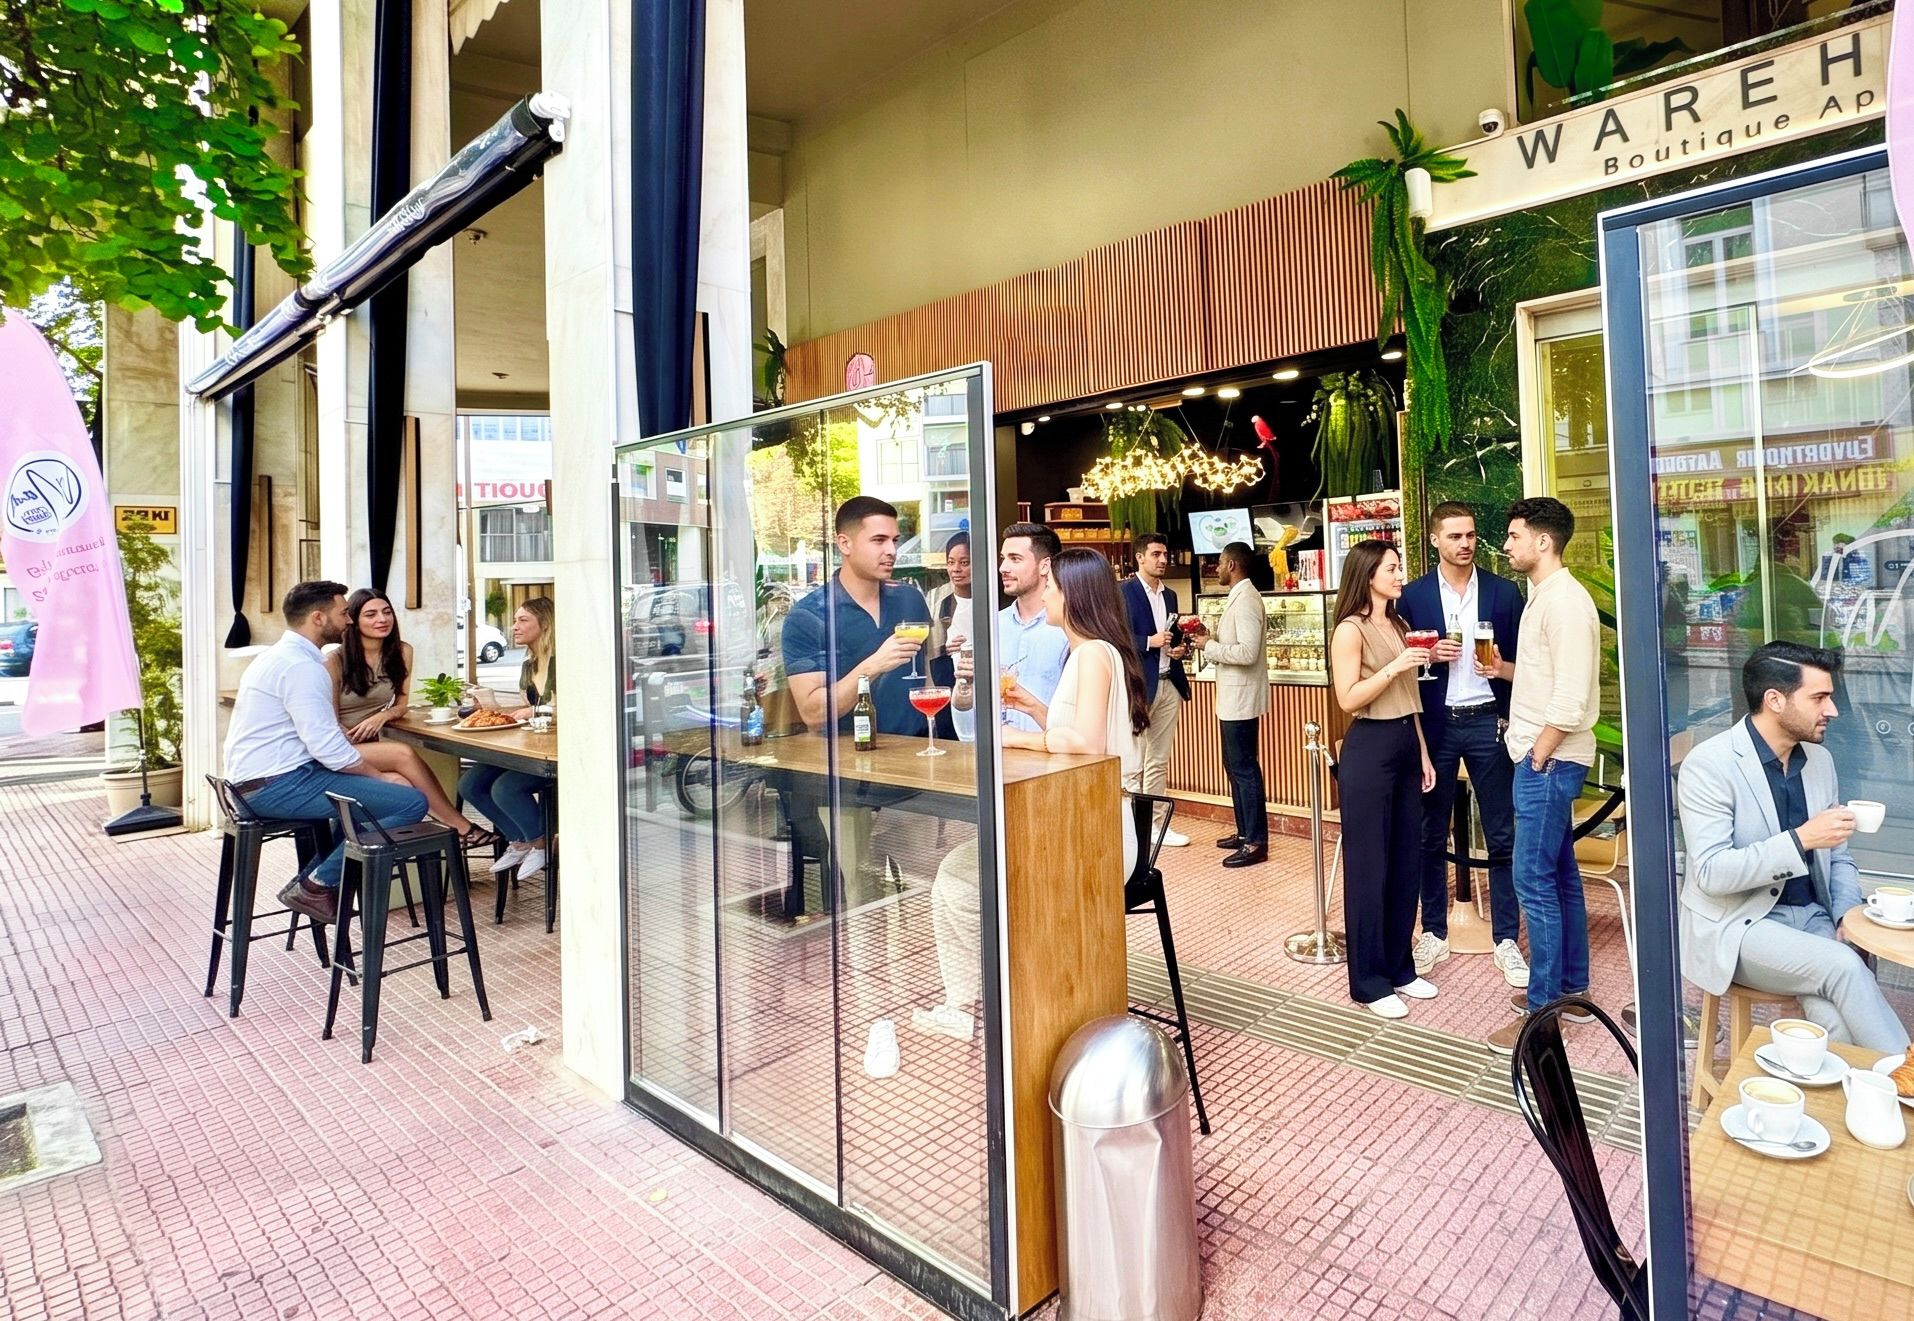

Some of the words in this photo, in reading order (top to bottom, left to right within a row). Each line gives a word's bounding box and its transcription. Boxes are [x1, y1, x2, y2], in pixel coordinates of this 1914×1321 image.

[1516, 32, 1862, 170] WAREH
[1604, 110, 1791, 176] Boutique
[1818, 88, 1876, 120] Ap
